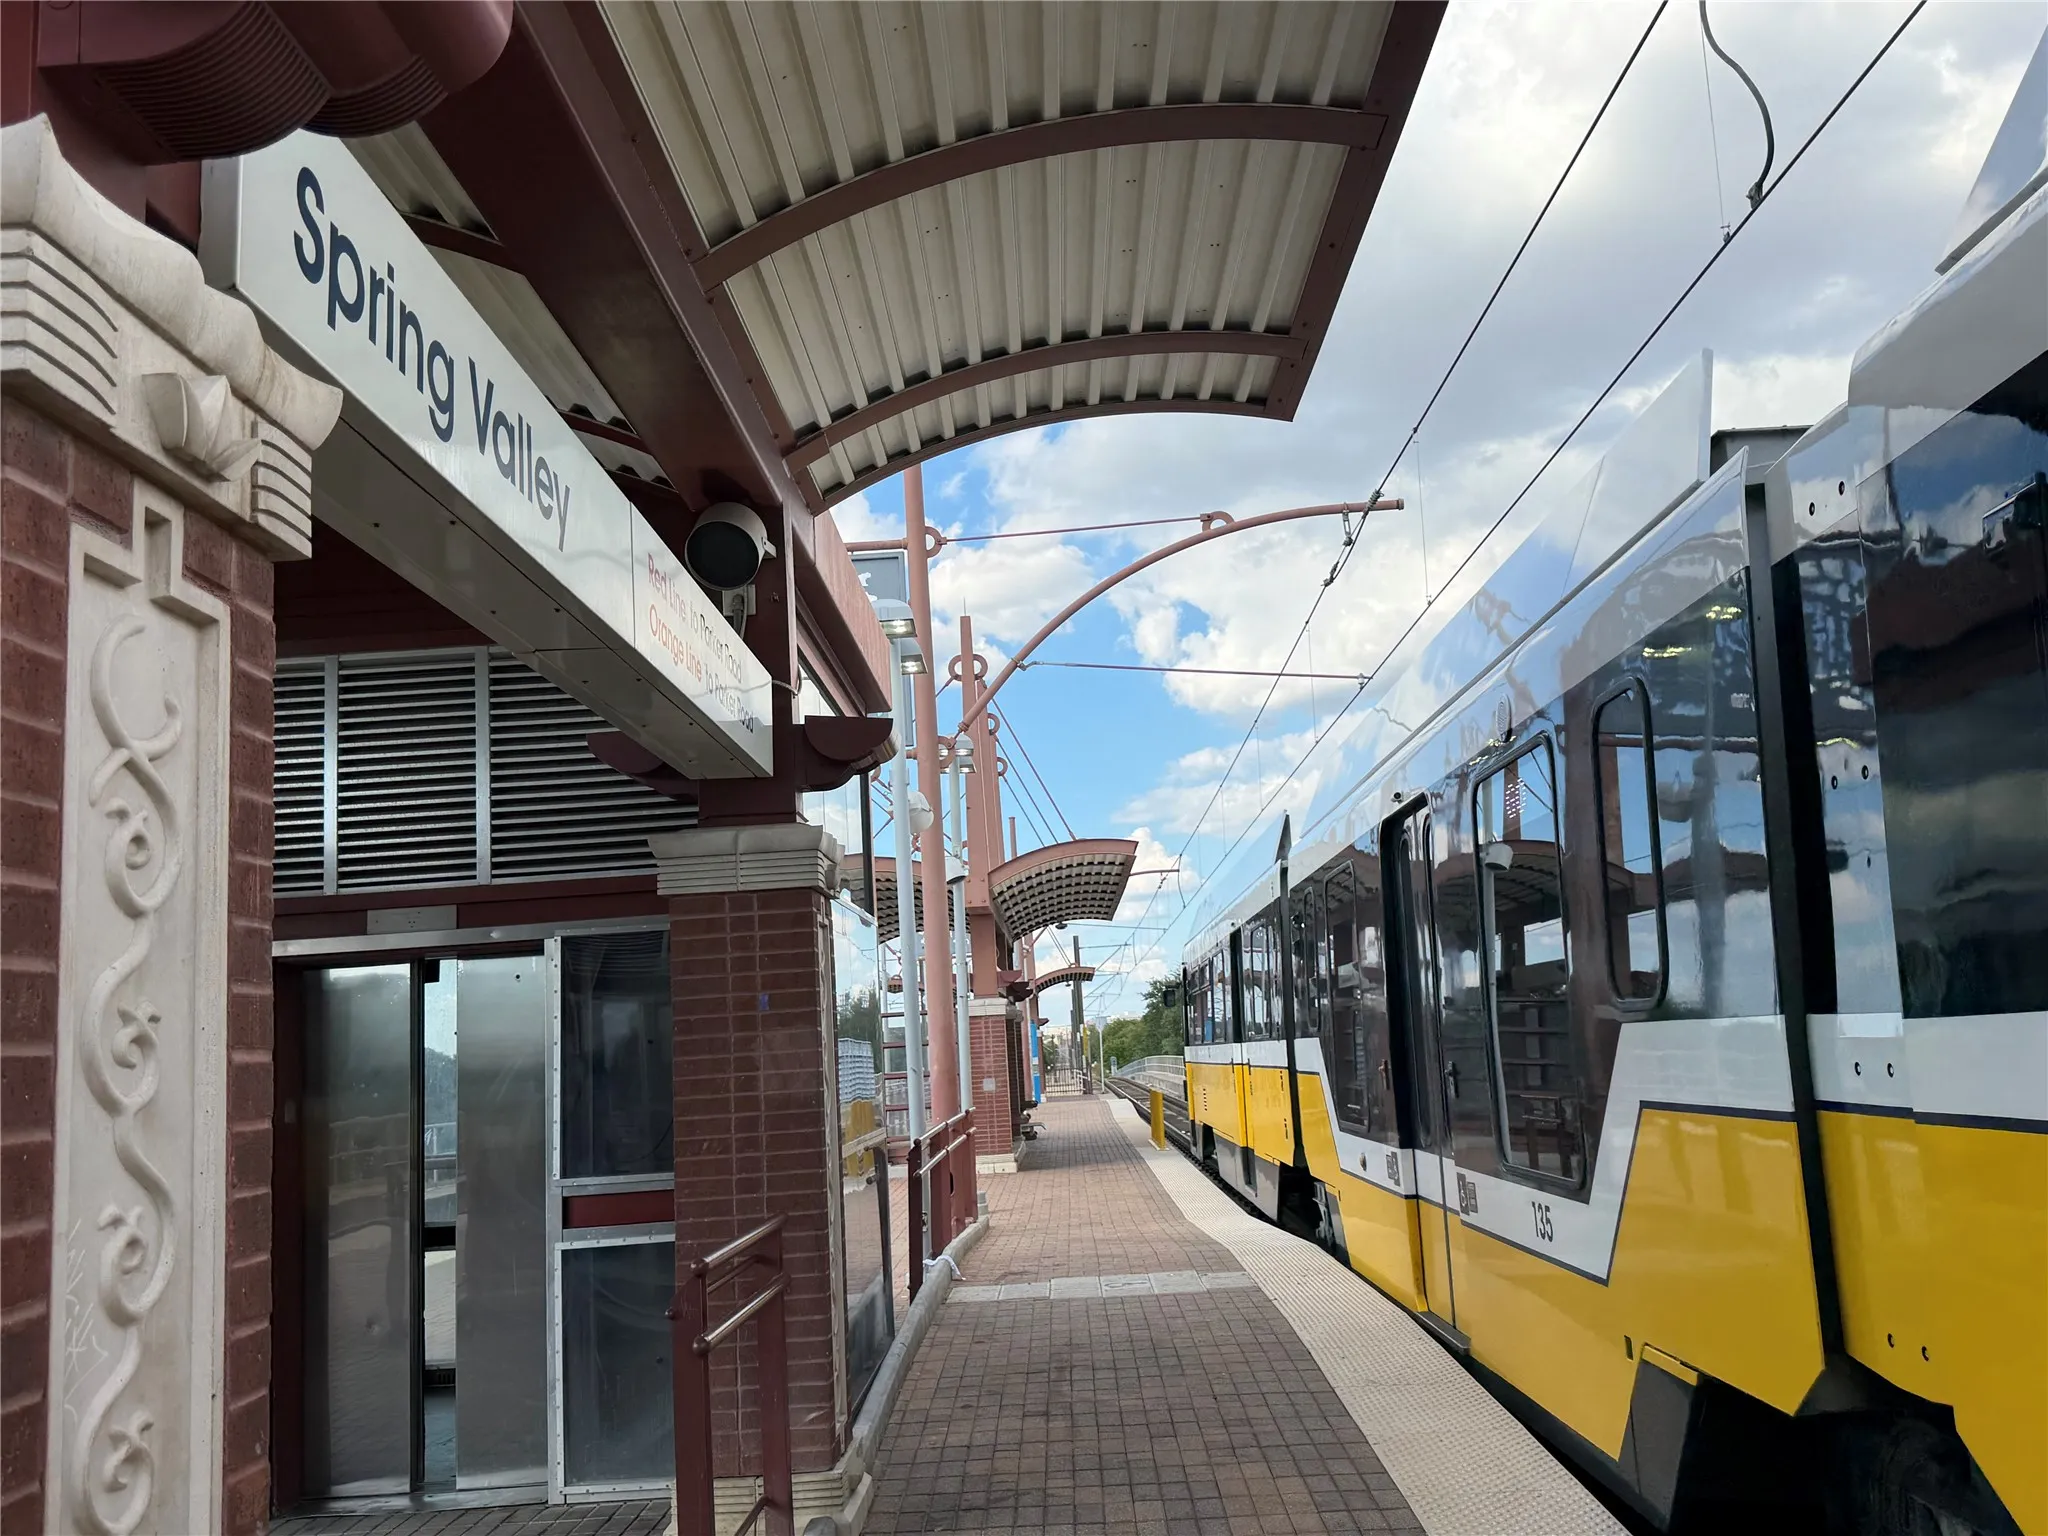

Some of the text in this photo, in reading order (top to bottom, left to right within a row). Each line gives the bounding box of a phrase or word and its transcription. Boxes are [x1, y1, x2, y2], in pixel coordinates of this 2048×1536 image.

[292, 166, 571, 553] Spring Valley
[647, 552, 667, 601] Red
[669, 577, 686, 622] Line
[700, 613, 724, 664] Parker
[724, 643, 741, 684] Road
[649, 604, 685, 667] Orange
[686, 641, 702, 683] Line
[714, 673, 735, 718] Parker
[736, 696, 753, 733] Road
[1531, 1201, 1554, 1243] 135
